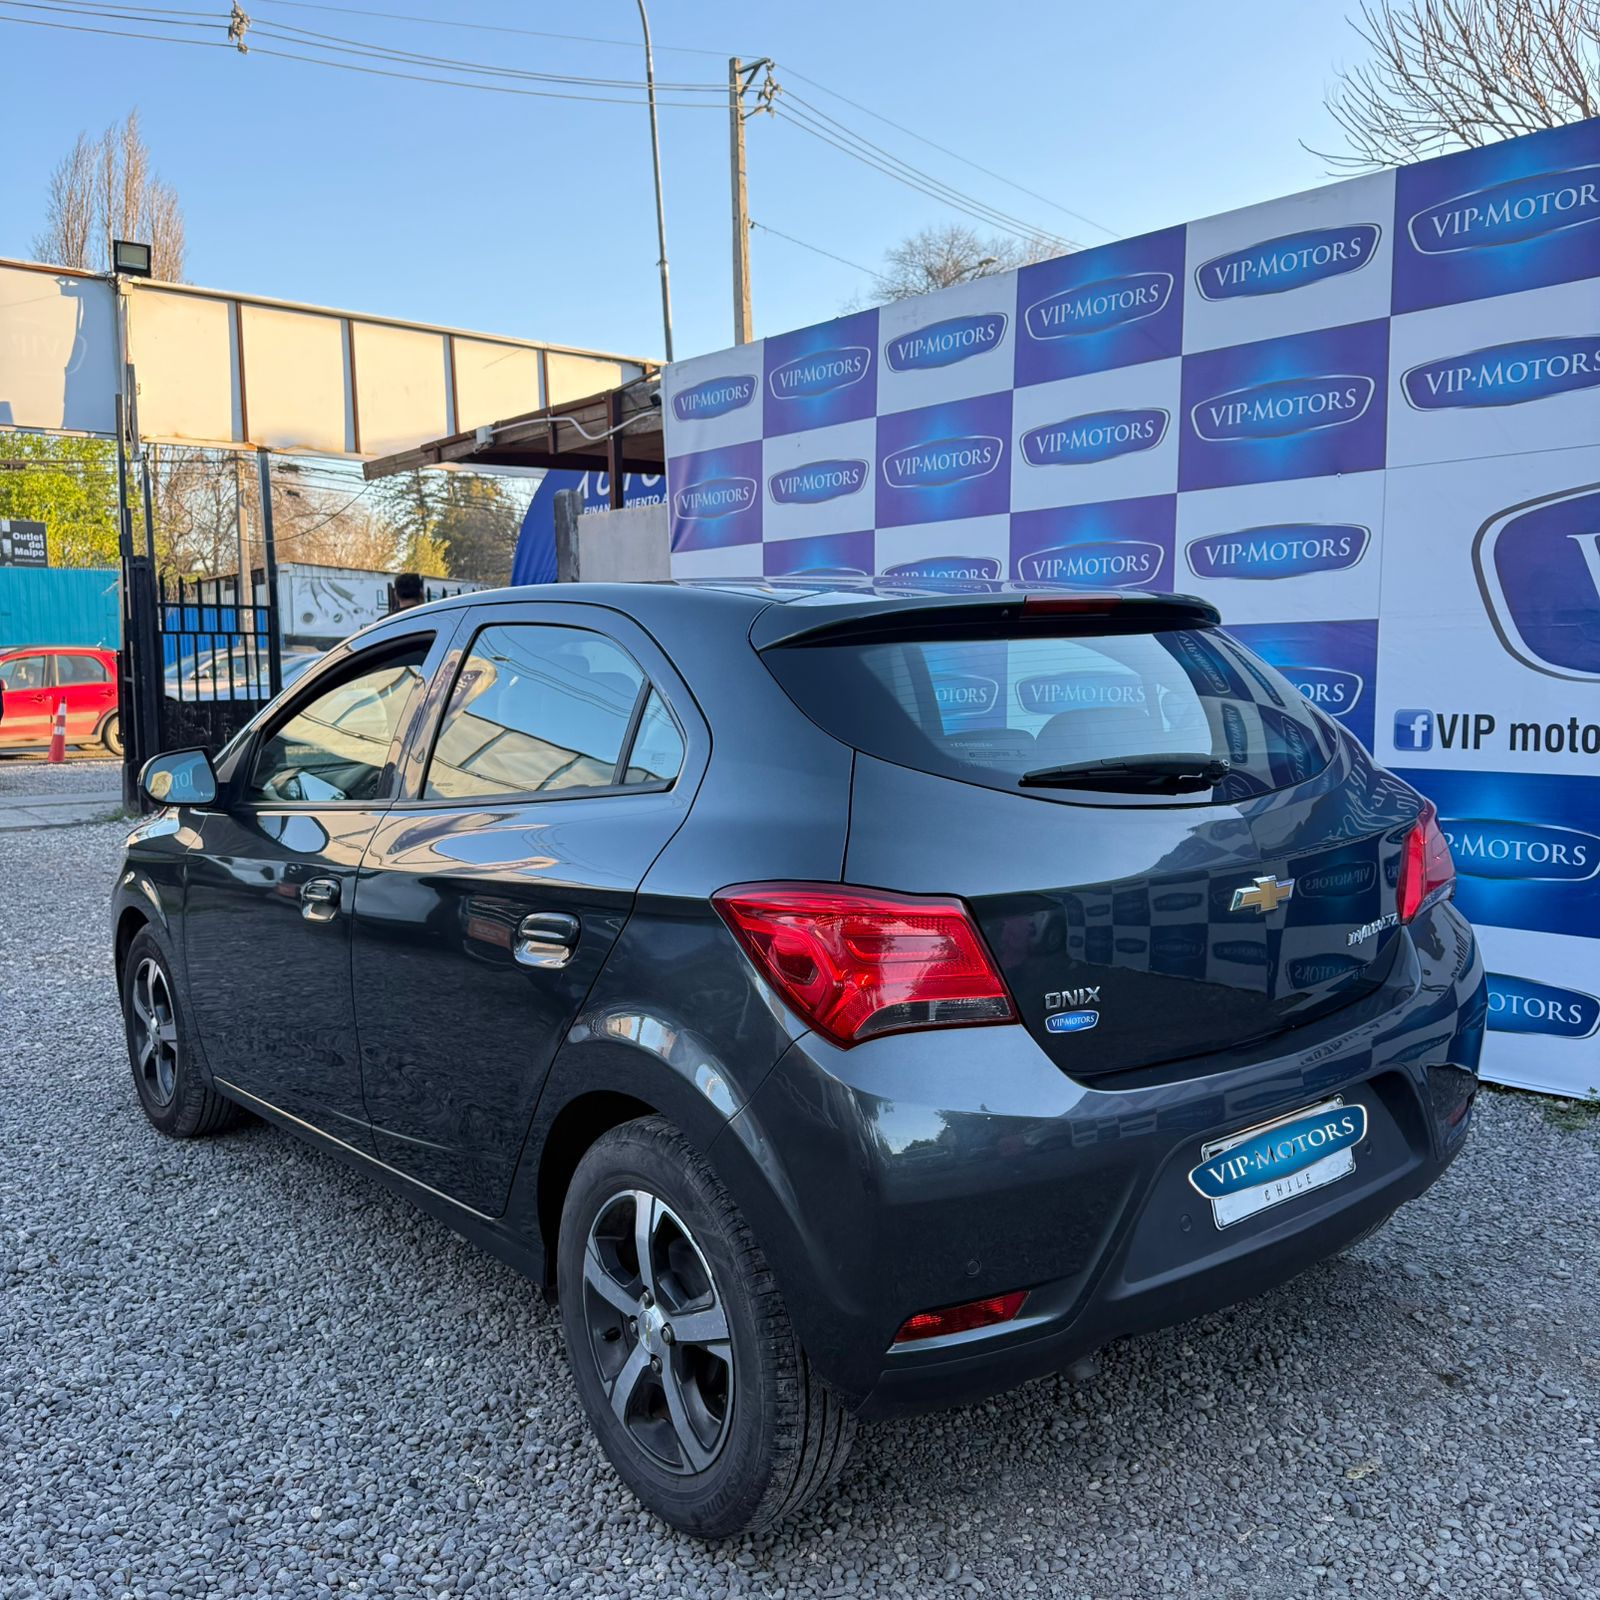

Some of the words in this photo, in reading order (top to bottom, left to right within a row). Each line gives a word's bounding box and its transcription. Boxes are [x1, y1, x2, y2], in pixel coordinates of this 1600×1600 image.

[12, 532, 44, 541] Outlet
[28, 541, 45, 549] del
[14, 547, 45, 558] Maipo
[1437, 713, 1495, 750] VIP
[1045, 985, 1100, 1010] ONIX
[1264, 1172, 1312, 1201] CHILE
